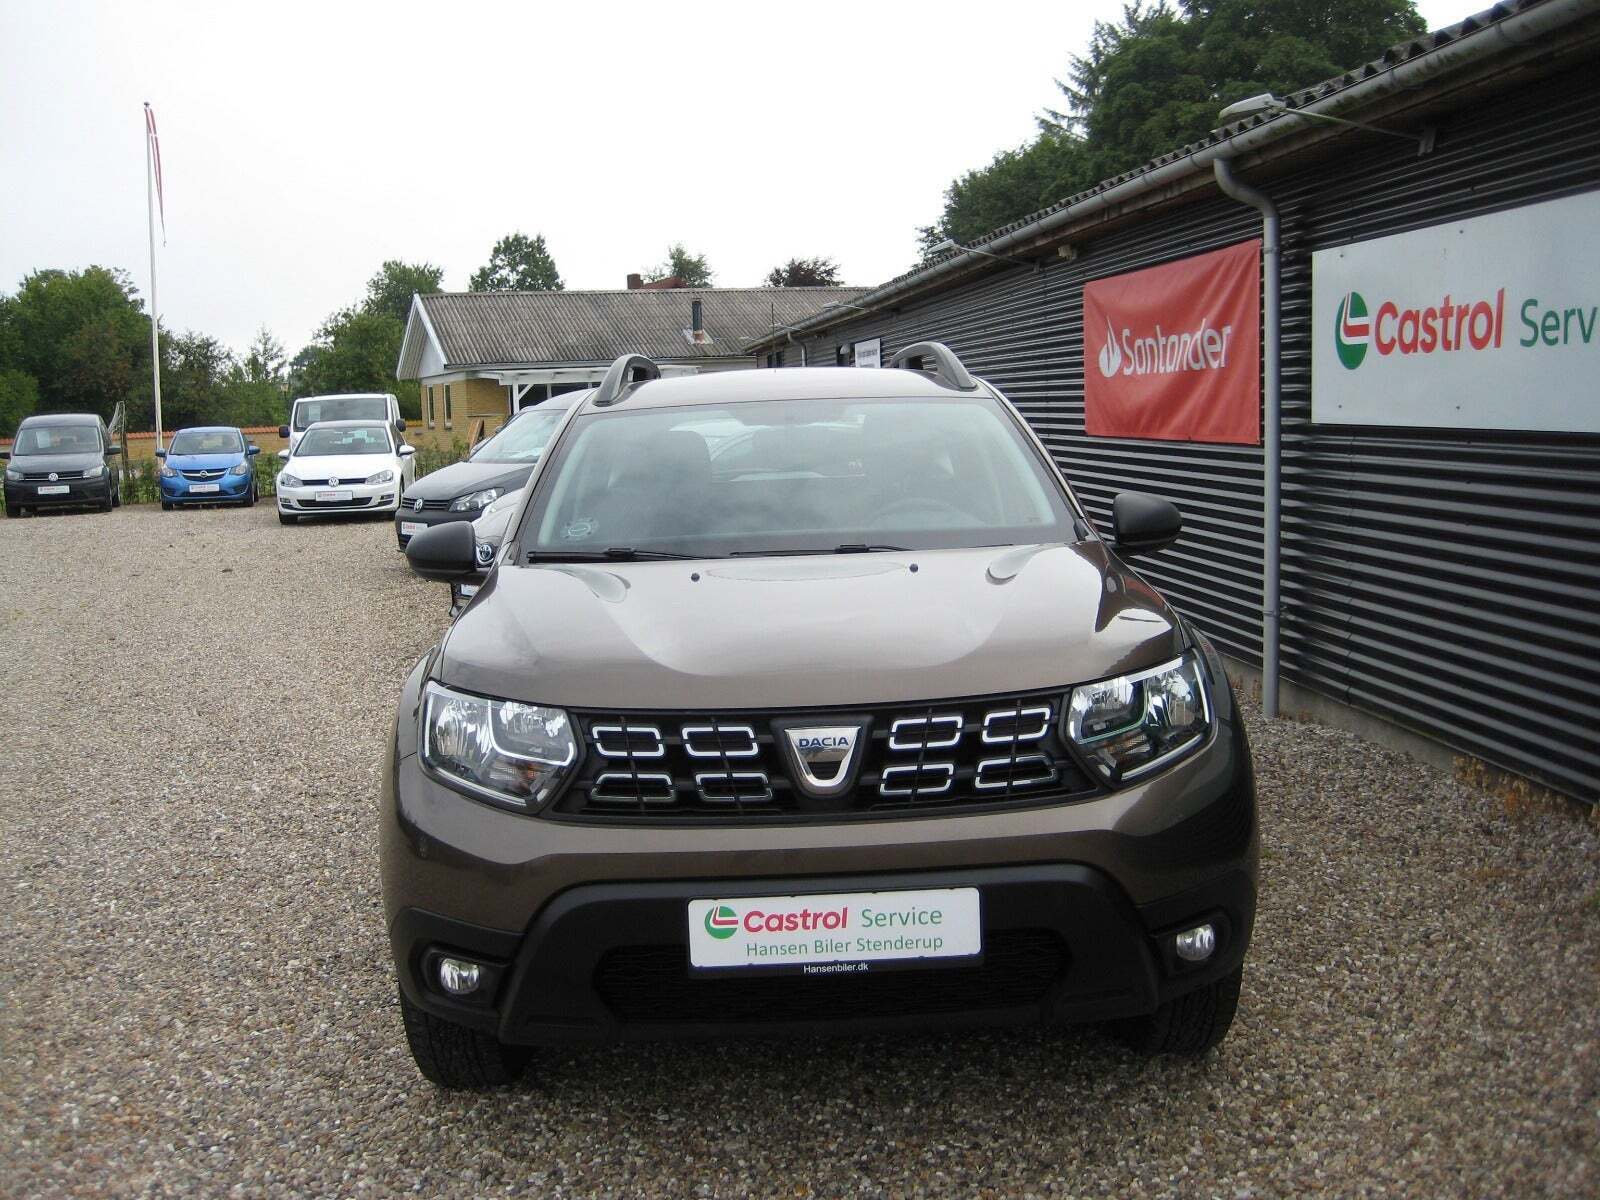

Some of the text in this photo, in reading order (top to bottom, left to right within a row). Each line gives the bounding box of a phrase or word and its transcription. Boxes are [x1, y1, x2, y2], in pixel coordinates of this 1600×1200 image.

[1374, 287, 1599, 356] Castrol Serv
[1122, 318, 1232, 376] Santander
[799, 736, 849, 748] DACIA
[743, 905, 943, 933] Castrol Service
[746, 933, 944, 957] Hansen Biler Stenderup
[803, 961, 869, 974] Hansenbiler.dk
